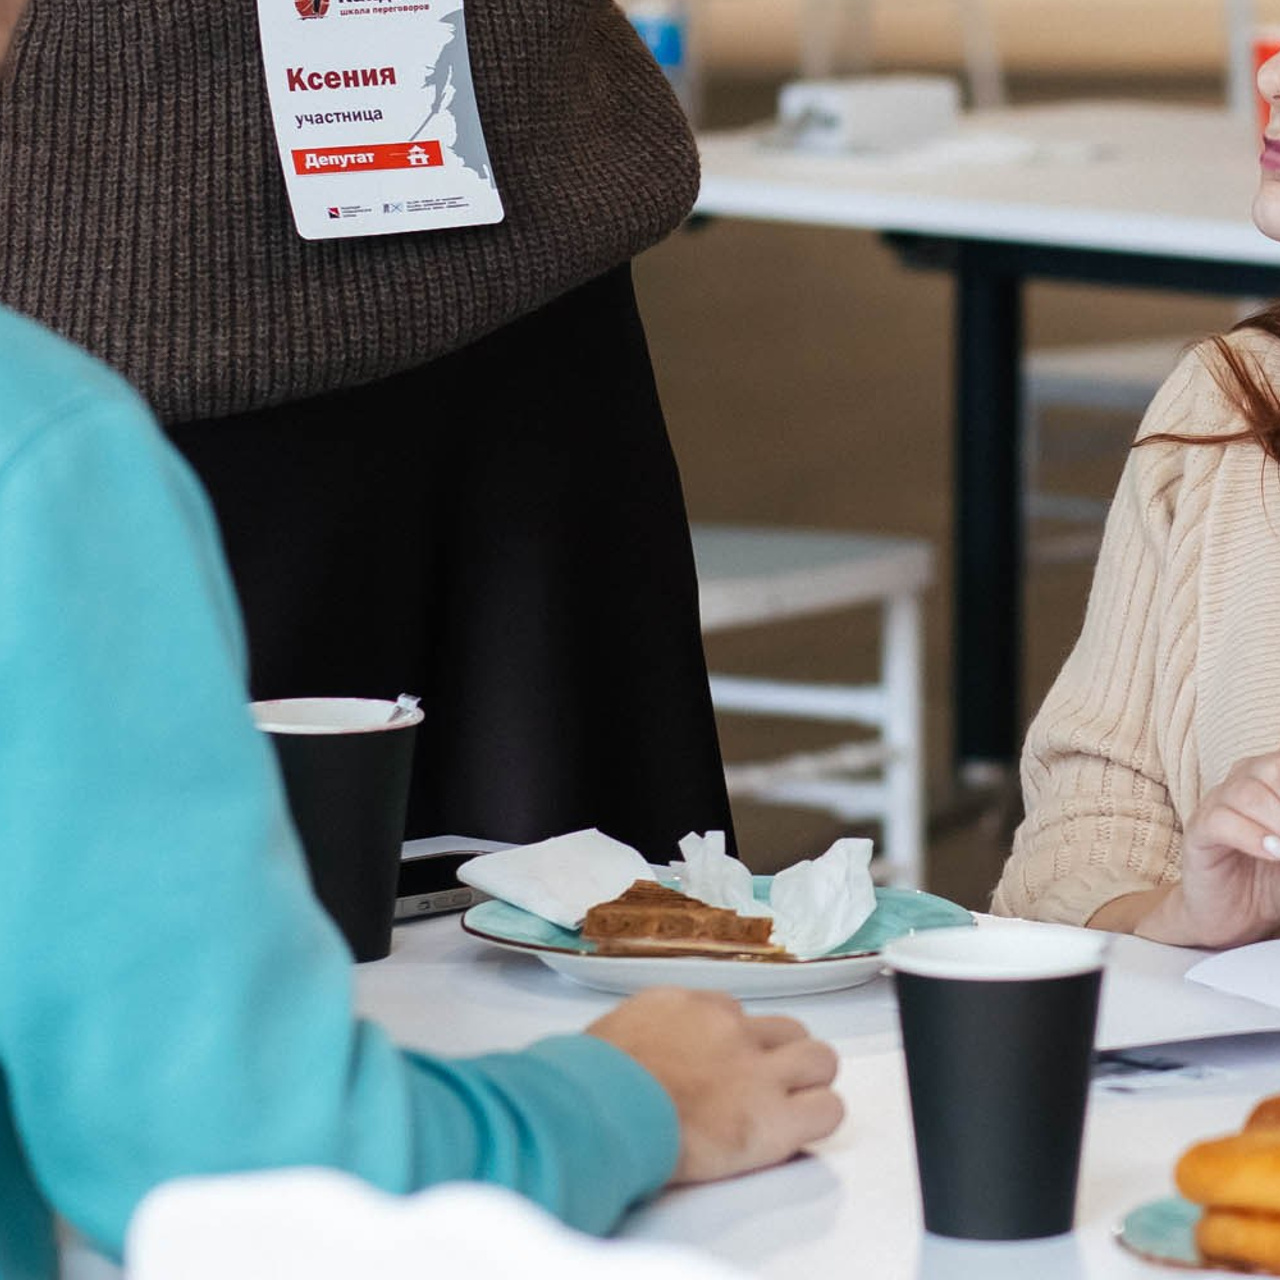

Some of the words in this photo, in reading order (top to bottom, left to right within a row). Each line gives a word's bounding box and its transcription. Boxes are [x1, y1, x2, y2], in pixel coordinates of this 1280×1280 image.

[340, 7, 370, 17] школа
[372, 4, 430, 15] переговоров
[286, 67, 396, 91] Ксения
[294, 108, 384, 129] участница
[305, 151, 375, 170] Депутат
